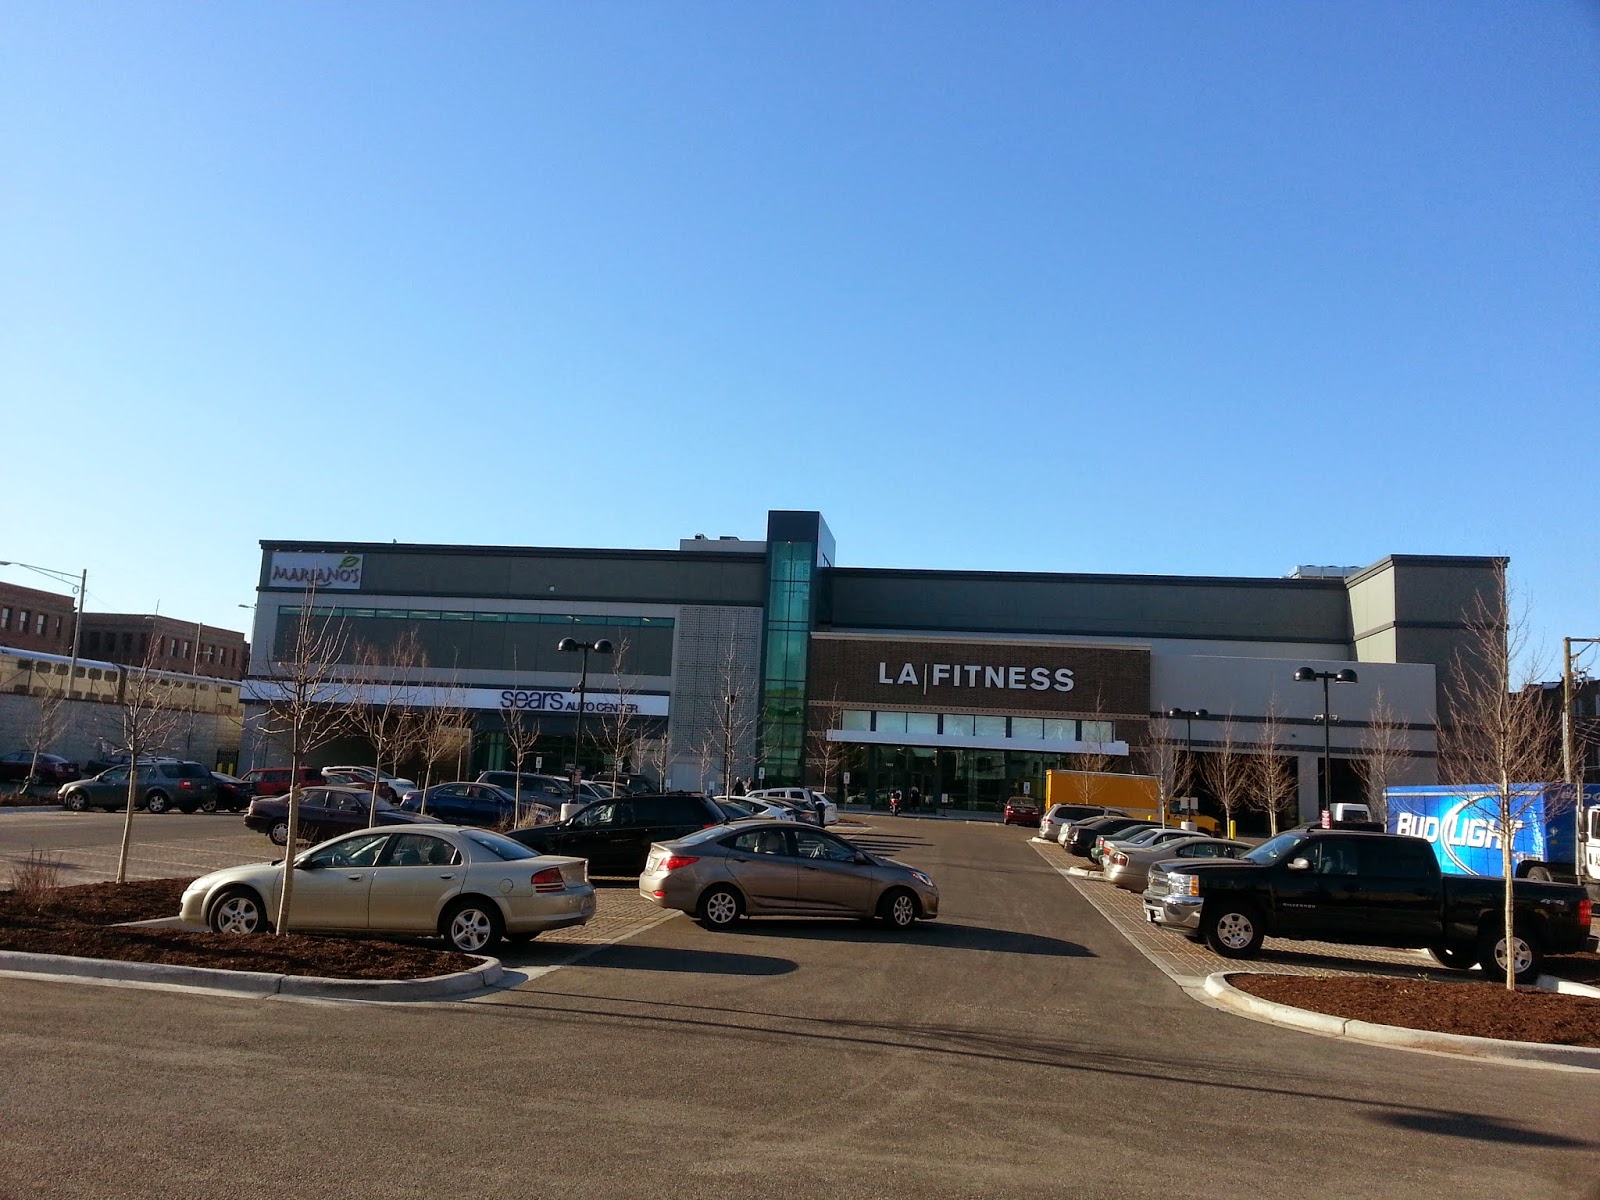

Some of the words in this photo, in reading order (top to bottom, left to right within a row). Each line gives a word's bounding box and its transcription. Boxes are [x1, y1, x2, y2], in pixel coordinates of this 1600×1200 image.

[273, 566, 359, 583] MARIANO'S
[879, 662, 918, 685] LA
[932, 663, 1075, 692] FITNESS
[500, 691, 563, 710] sears
[1397, 812, 1439, 843] BUD
